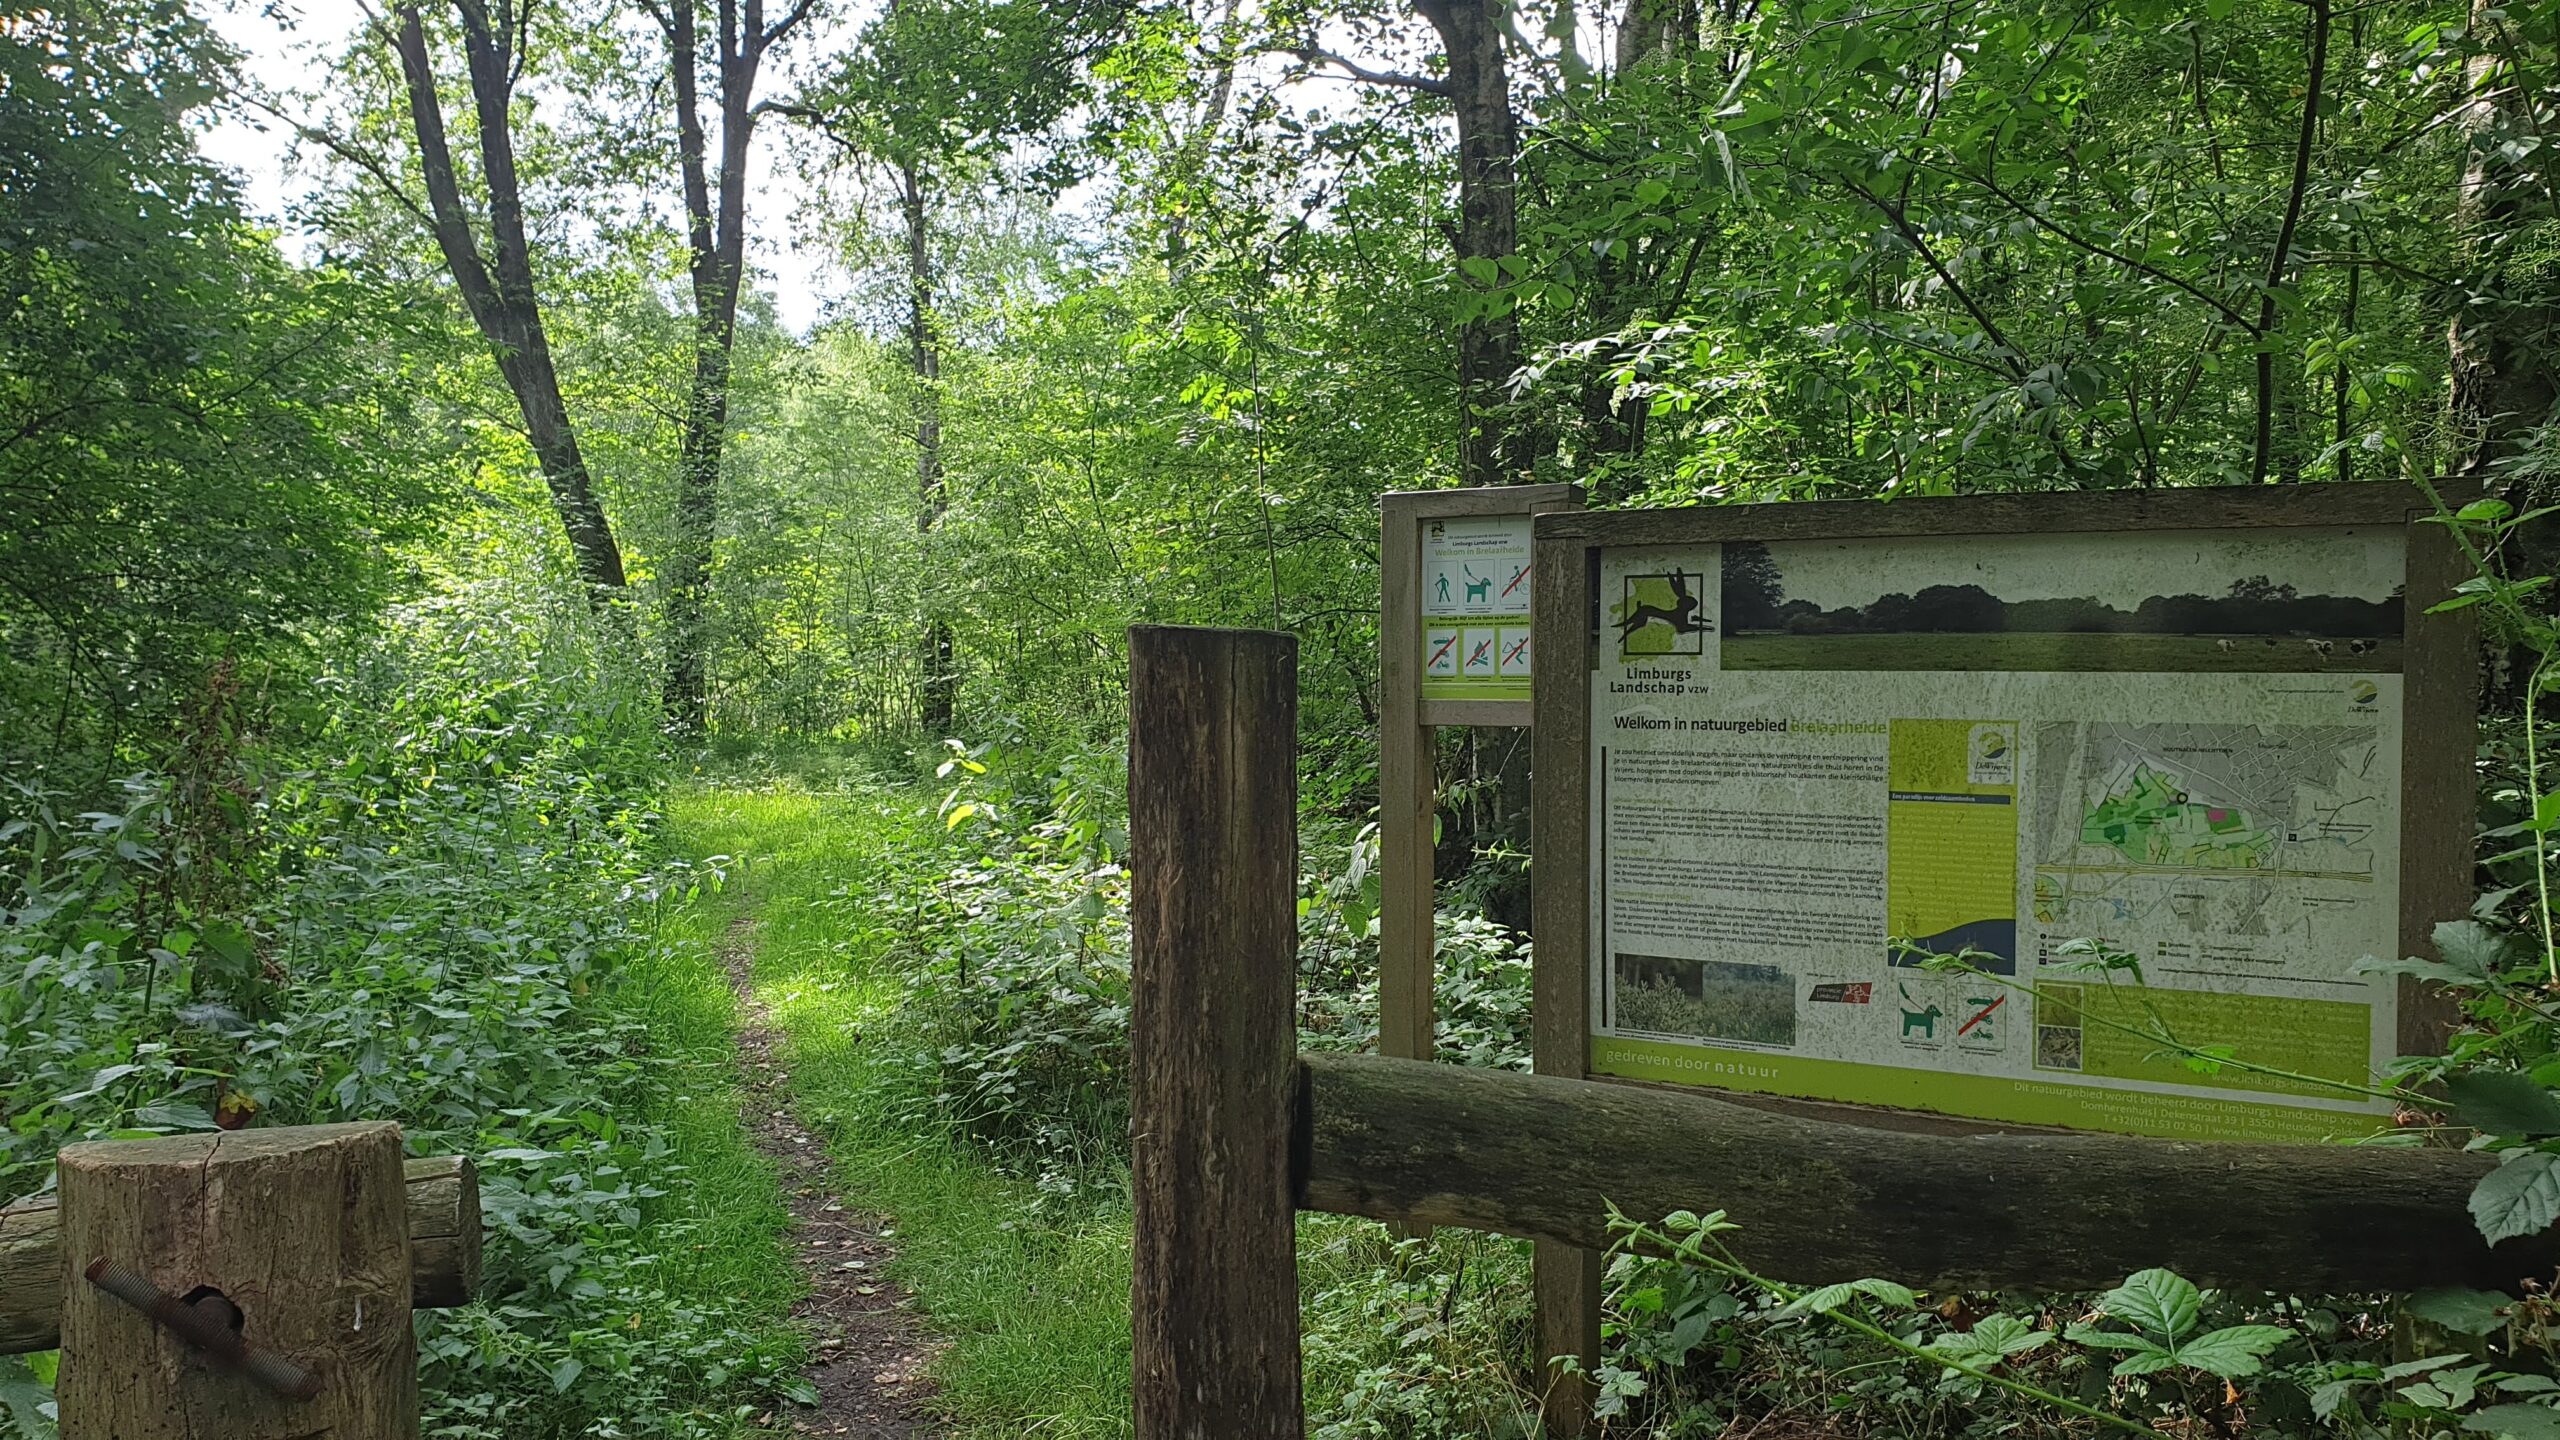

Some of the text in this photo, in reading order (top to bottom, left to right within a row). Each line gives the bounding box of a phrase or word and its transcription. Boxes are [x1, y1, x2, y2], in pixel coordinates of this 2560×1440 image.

[1434, 545, 1525, 557] Welkom in Brelaarheide
[1627, 667, 1691, 682] Limburgs
[1610, 681, 1709, 696] Landschap vzw
[1614, 716, 1887, 734] Welkom in natuurgebied Brelaarheide
[1606, 1049, 1778, 1078] gedreven door natuur
[2014, 1082, 2364, 1127] Dit natuurgebied wordt beheerd door Limburgs Landschap vzw
[2103, 1114, 2109, 1124] T
[2111, 1116, 2156, 1129] +32(0)11
[2159, 1120, 2171, 1130] 53
[2173, 1121, 2186, 1131] 02
[2189, 1123, 2202, 1133] 50
[2161, 1109, 2221, 1123] Dekenstraat
[2224, 1115, 2237, 1124] 39
[2248, 1118, 2275, 1129] 3550
